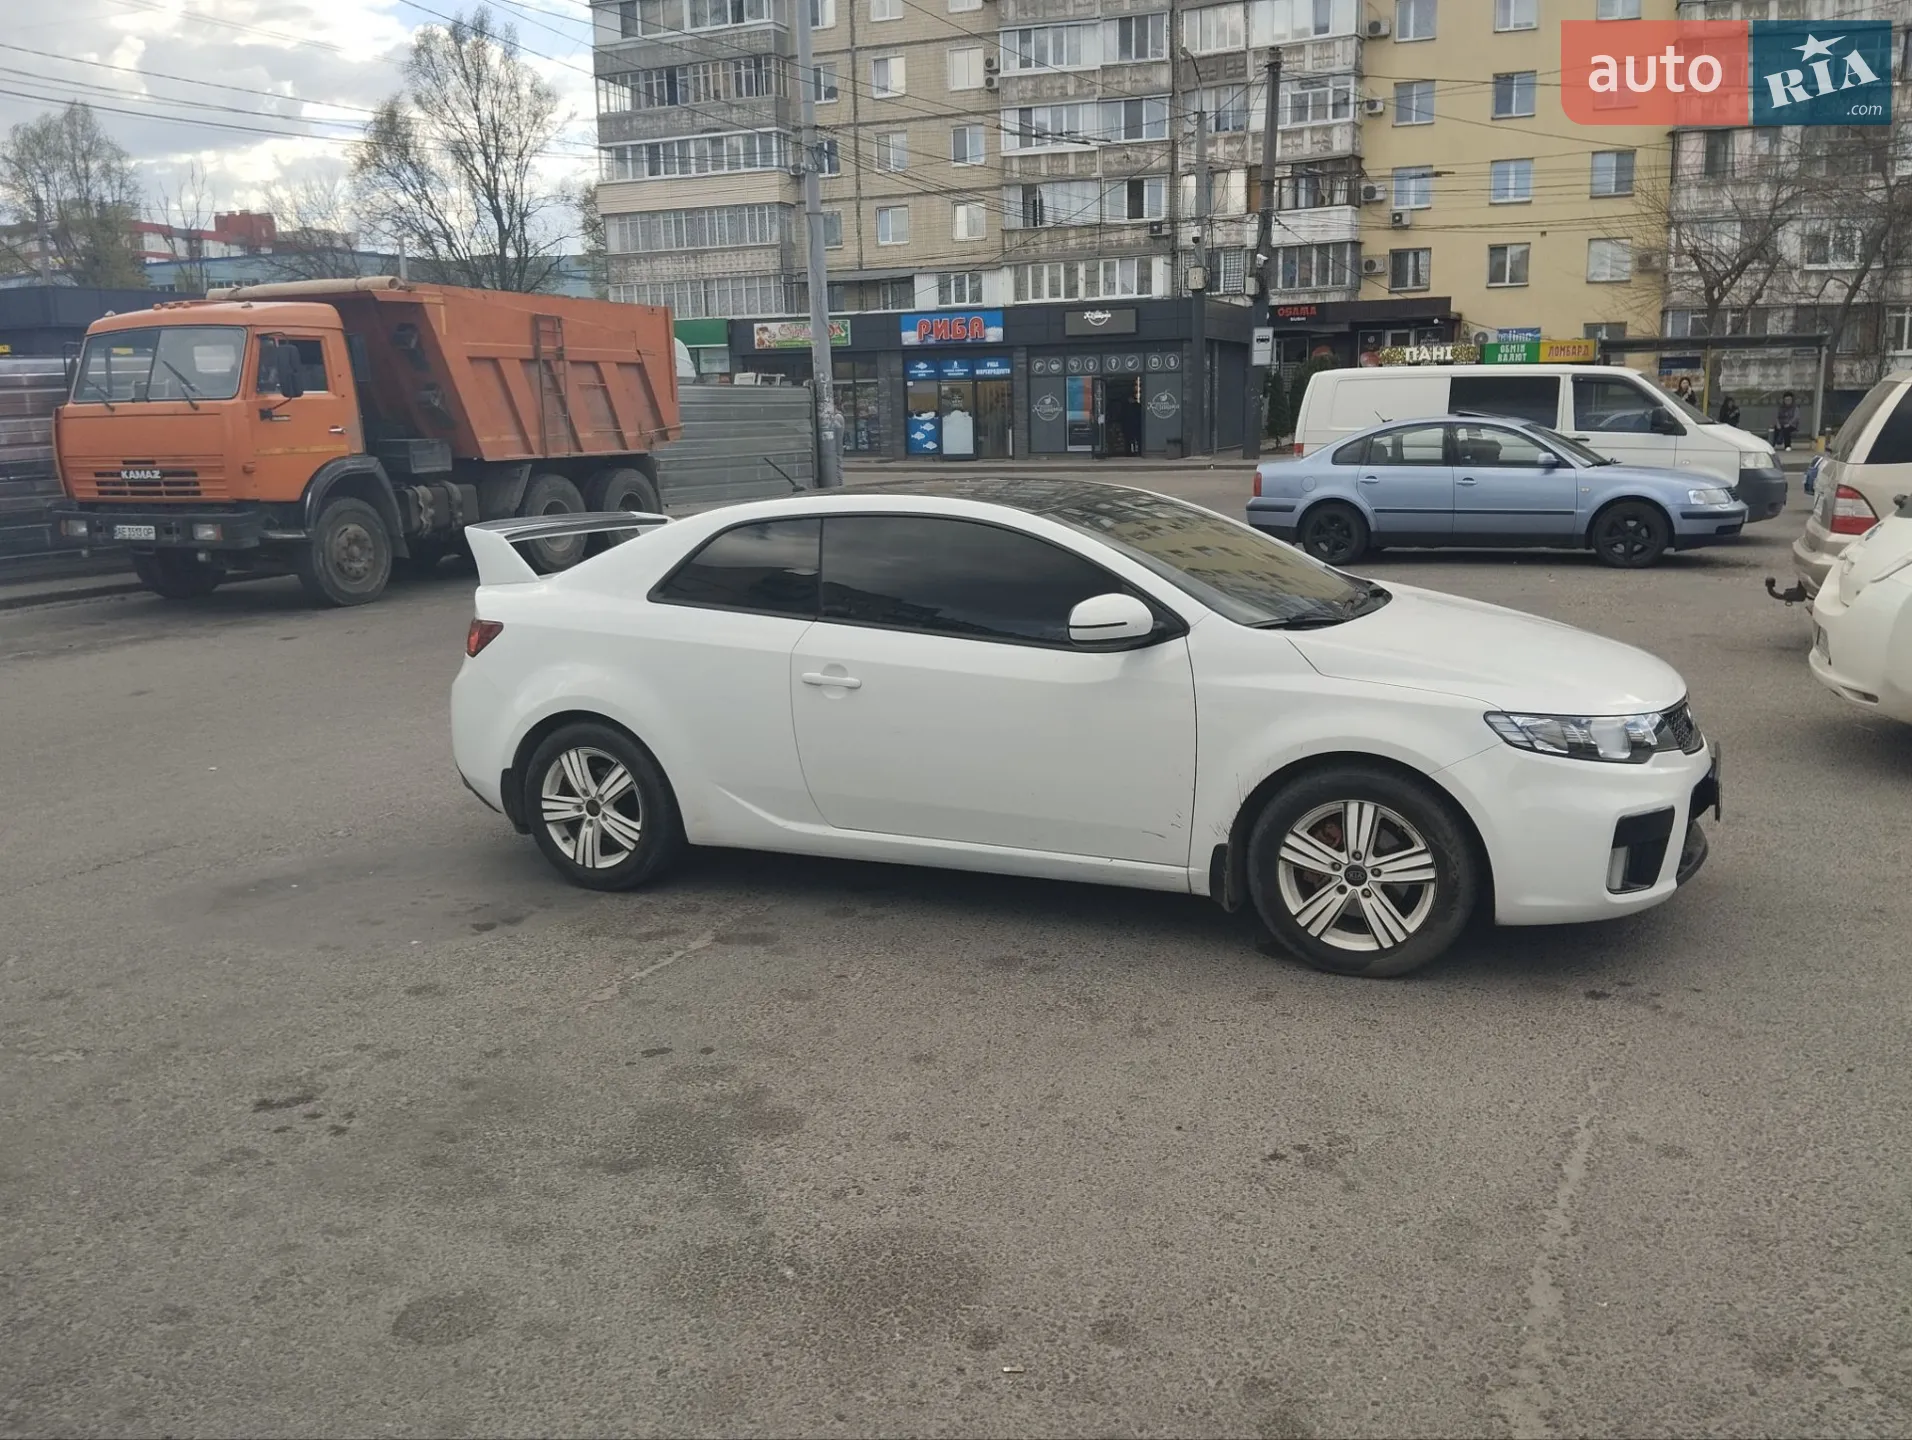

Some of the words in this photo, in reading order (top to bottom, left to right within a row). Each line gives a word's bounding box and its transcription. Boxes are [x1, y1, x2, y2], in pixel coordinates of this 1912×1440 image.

[916, 316, 985, 341] РИБА
[1500, 343, 1526, 353] ОБМІН
[1547, 344, 1589, 358] ЛОМБАРД
[1497, 353, 1527, 362] ВАЛЮТ
[121, 470, 161, 479] KAMAZ
